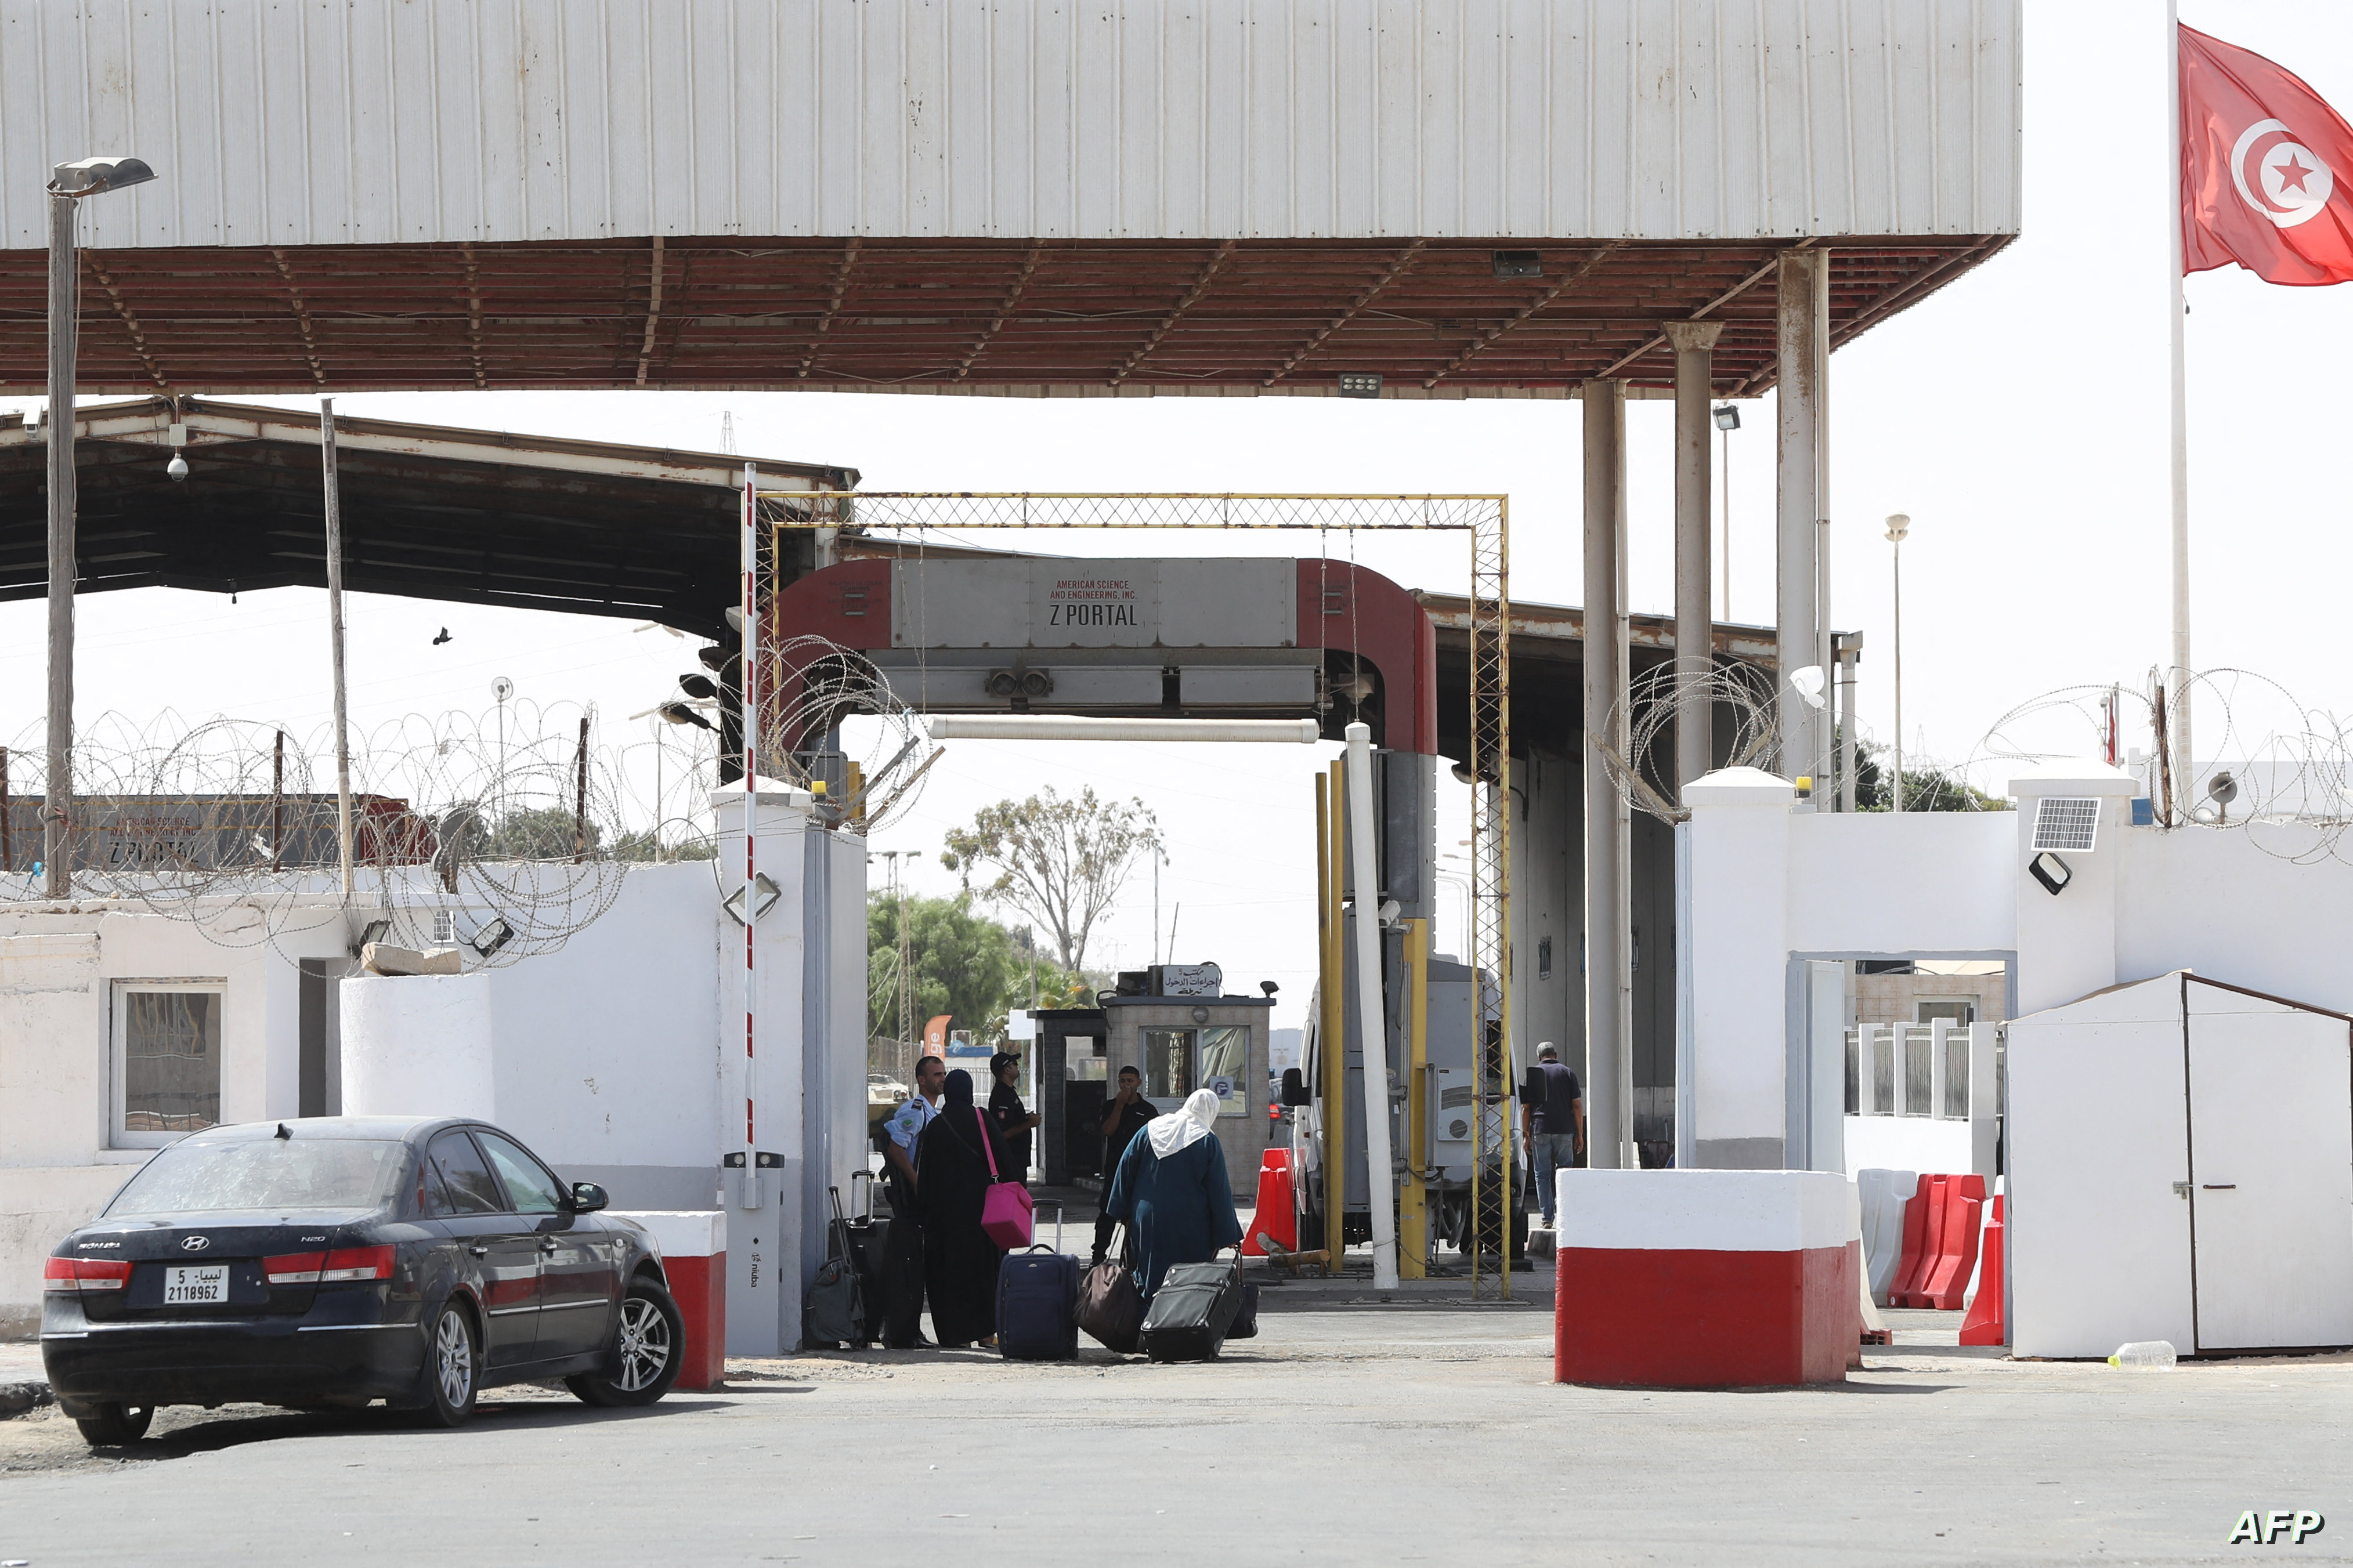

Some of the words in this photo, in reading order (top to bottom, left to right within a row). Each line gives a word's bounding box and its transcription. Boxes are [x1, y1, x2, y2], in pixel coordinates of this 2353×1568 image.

[1056, 580, 1095, 589] AMERICAN
[1097, 580, 1129, 589] SCIENCE
[1050, 591, 1065, 599] AND
[1067, 591, 1120, 600] ENGINEERING,
[1122, 591, 1137, 599] INC.
[1050, 604, 1060, 626] Z
[1066, 604, 1138, 626] PORTAL
[110, 842, 120, 863] Z
[1183, 967, 1204, 979] مكتب
[1165, 977, 1188, 987] الدخول
[1177, 988, 1203, 996] شرطة
[178, 1269, 186, 1284] 5
[751, 1263, 760, 1288] niuba
[168, 1285, 218, 1301] 2118962
